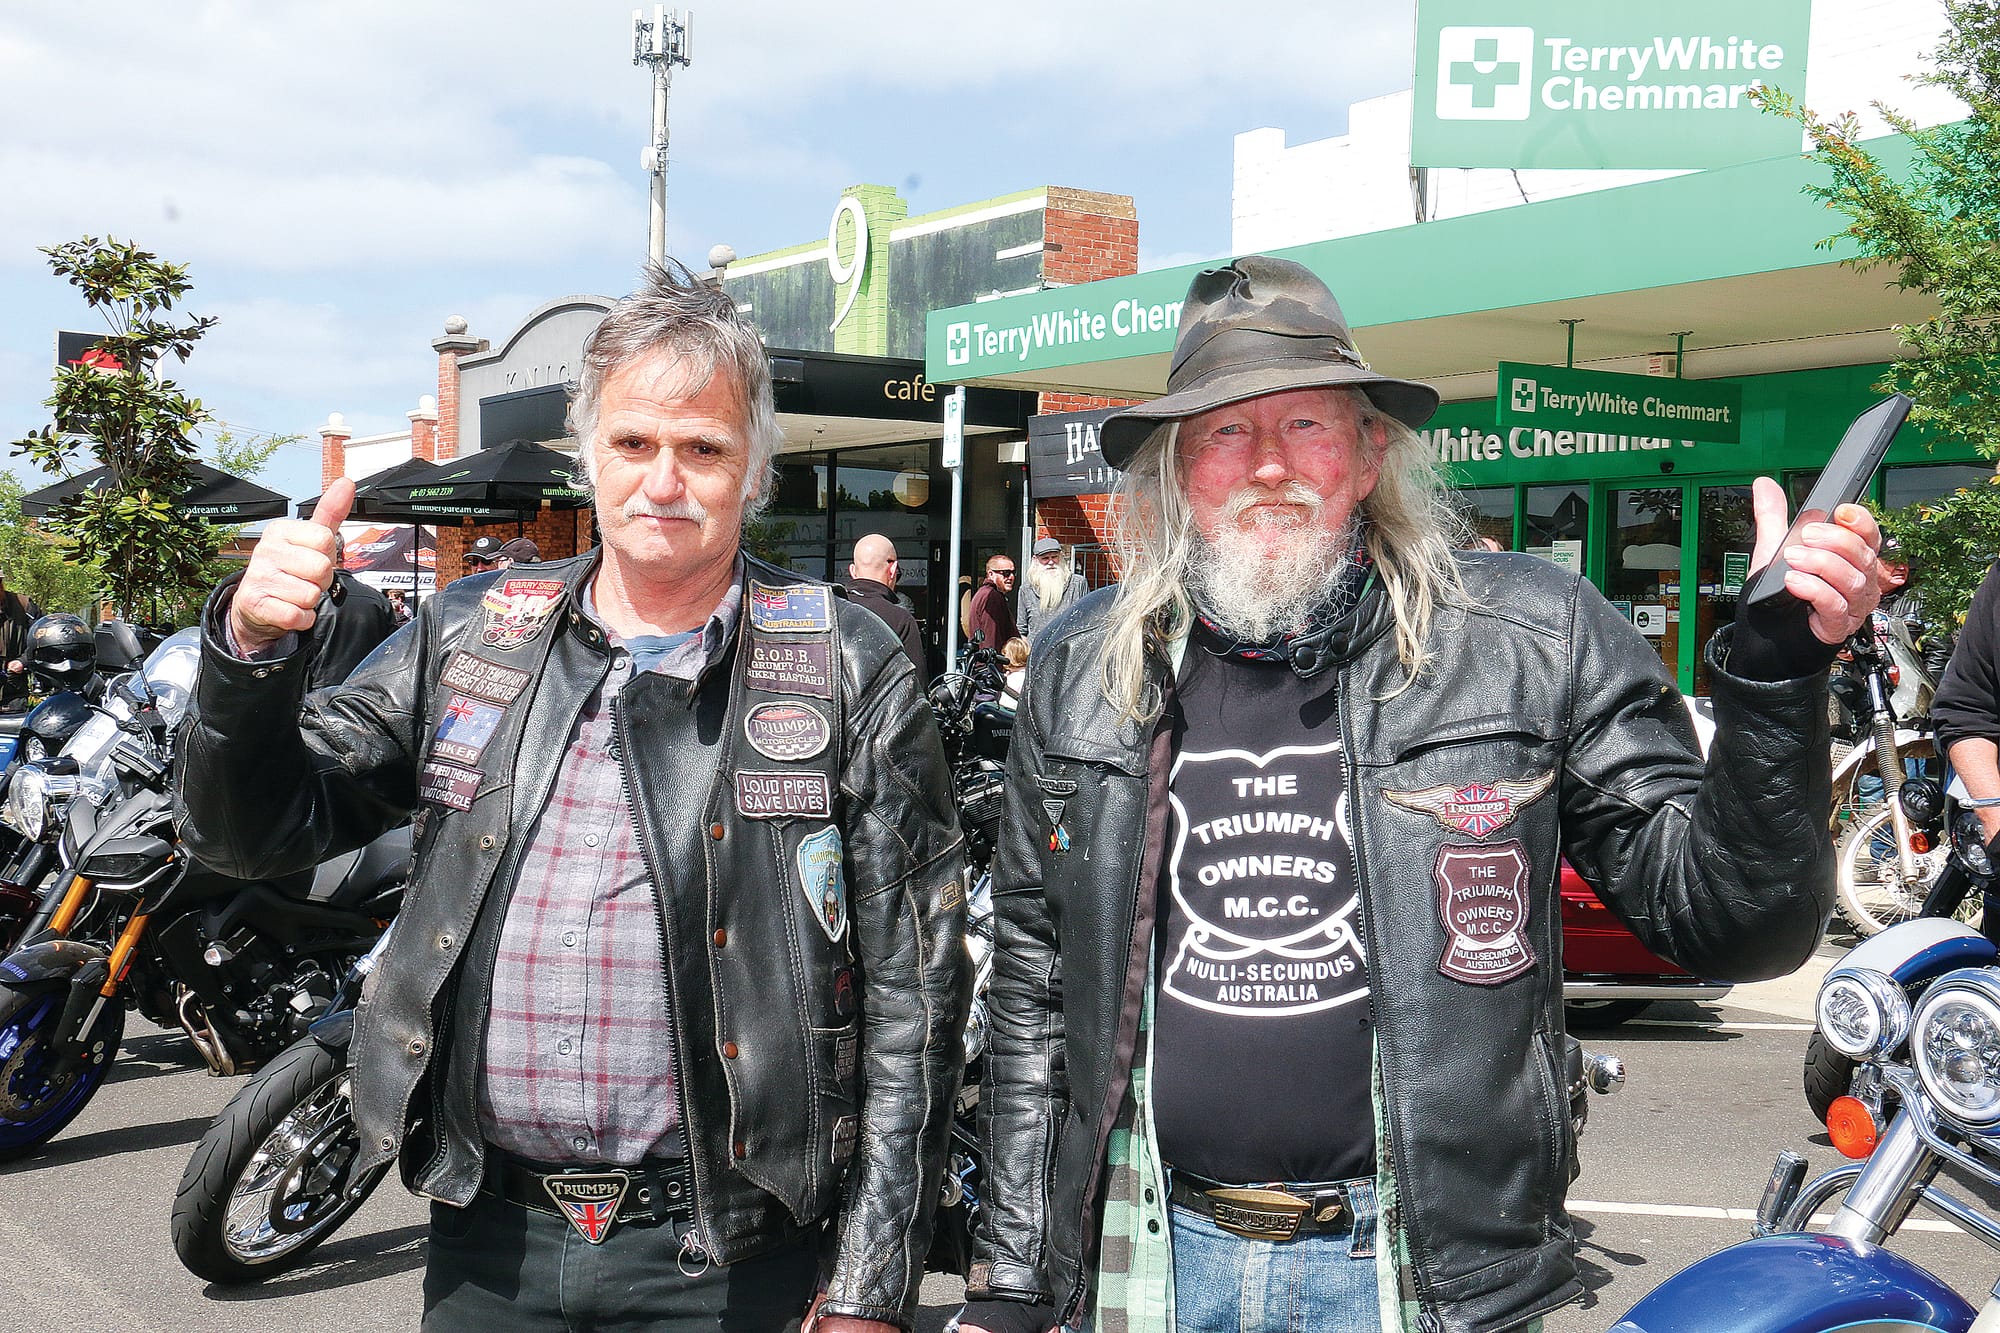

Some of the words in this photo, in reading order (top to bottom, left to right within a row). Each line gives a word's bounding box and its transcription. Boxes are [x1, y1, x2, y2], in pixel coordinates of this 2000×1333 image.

[1544, 36, 1784, 81] TerryWhite
[827, 197, 868, 334] 9
[973, 307, 1106, 361] TerryWhite
[884, 374, 936, 402] cafe
[1540, 386, 1638, 417] TerryWhite
[1642, 396, 1730, 423] Chemmart
[1064, 422, 1103, 466] HA
[763, 620, 816, 628] AUSTRALIAN
[754, 647, 812, 664] G.O.B.B.
[453, 653, 479, 674] FEAR
[474, 660, 488, 677] IS
[483, 665, 530, 688] TEMPORARY
[751, 660, 794, 671] GRUMPY
[444, 667, 480, 691] REGRET
[474, 677, 488, 693] IS
[482, 680, 520, 702] FOREVER
[779, 671, 825, 686] BASTARD
[752, 718, 818, 734] TRIUMPH
[755, 735, 821, 745] MOTORCYCLES
[436, 776, 456, 791] HAVE
[450, 767, 482, 785] THERAPY
[742, 777, 780, 795] LOUD
[783, 779, 822, 795] PIPES
[1232, 774, 1298, 798] THE
[744, 794, 783, 810] SAVE
[785, 795, 825, 810] LIVES
[1449, 801, 1506, 815] TRIUMPH
[1191, 811, 1335, 845] TRIUMPH
[1197, 854, 1337, 887] OWNERS
[1468, 865, 1497, 879] THE
[1454, 884, 1514, 903] TRIUMPH
[1223, 895, 1319, 919] M.C.C.
[1456, 906, 1515, 925] OWNERS
[1466, 921, 1506, 935] M.C.C.
[1454, 944, 1520, 959] NULLI-SECUNDUS
[1186, 954, 1356, 982] NULLI-SECUNDUS
[1465, 957, 1511, 969] AUSTRALIA
[1216, 984, 1319, 1002] AUSTRALIA
[552, 1181, 620, 1199] TRIUMPH
